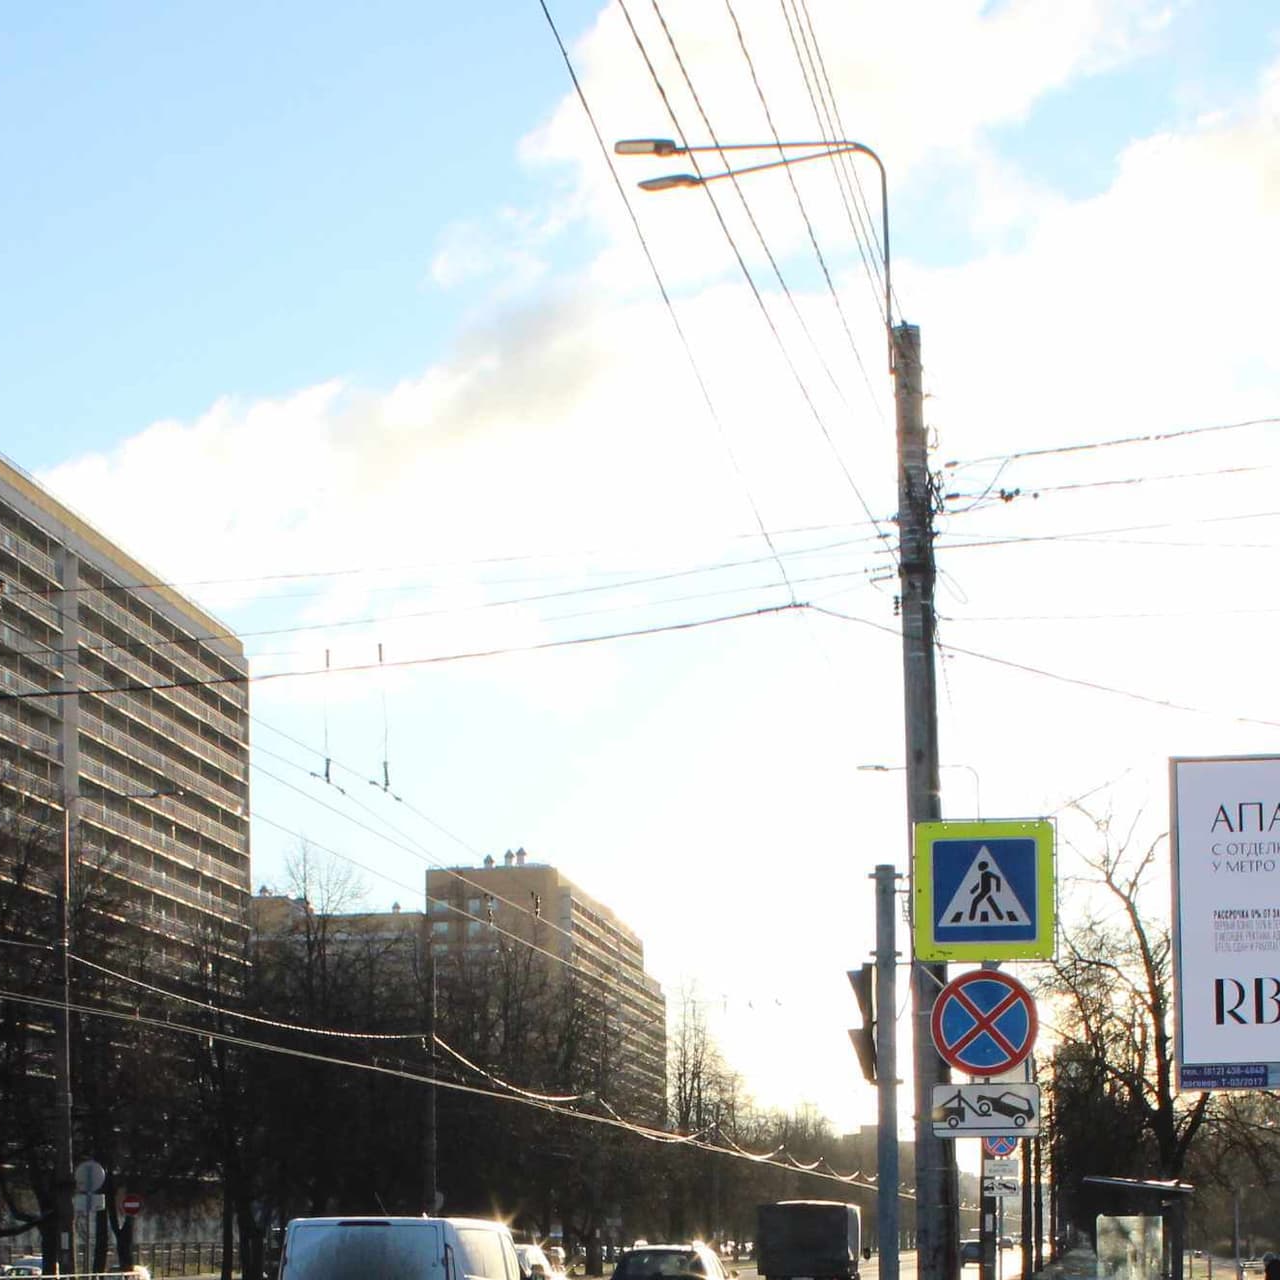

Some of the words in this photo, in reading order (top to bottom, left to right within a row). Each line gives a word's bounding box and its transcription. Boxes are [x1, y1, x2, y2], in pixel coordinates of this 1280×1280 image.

[1212, 843, 1221, 856] С
[1212, 861, 1221, 873] У
[1226, 859, 1276, 873] МЕТРО
